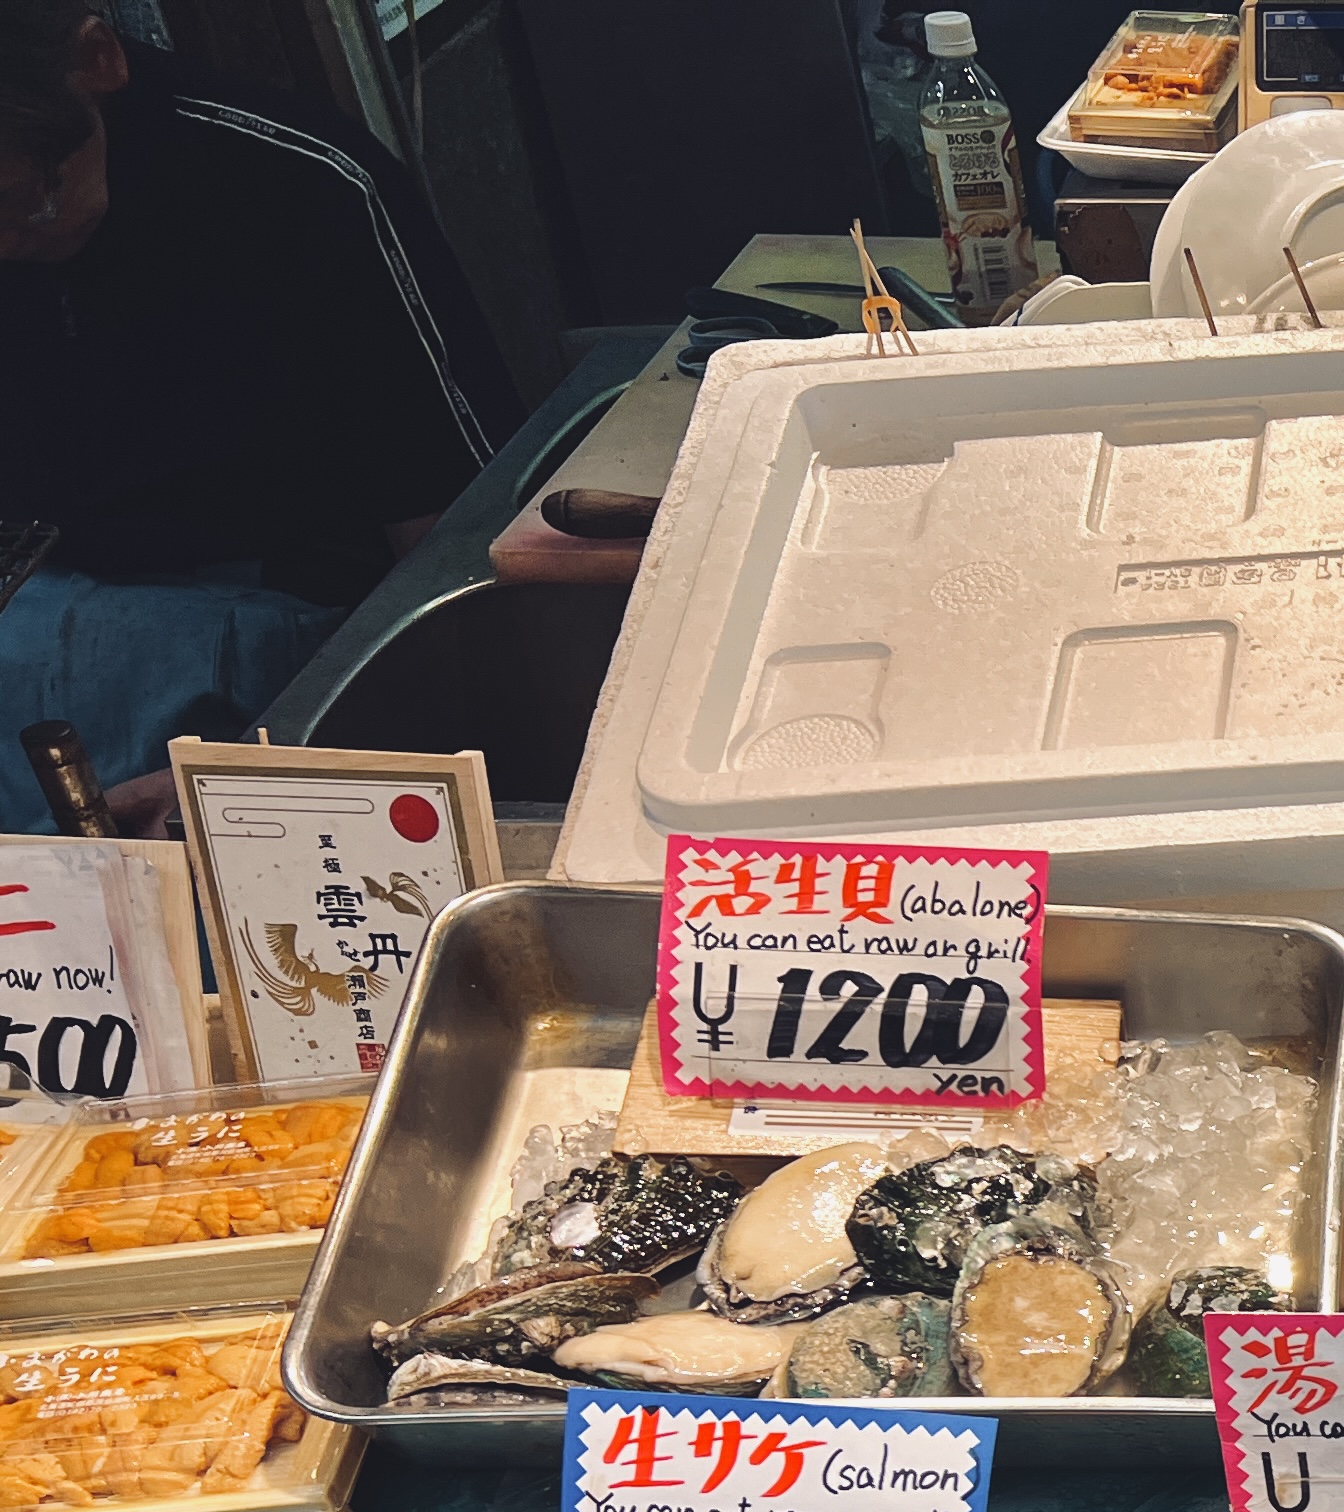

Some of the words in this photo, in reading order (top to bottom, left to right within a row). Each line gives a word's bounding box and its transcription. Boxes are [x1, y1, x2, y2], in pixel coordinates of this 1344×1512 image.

[946, 132, 981, 146] BOSS
[952, 169, 1001, 183] カフェオレ
[685, 854, 896, 925] 活生貝
[899, 881, 1042, 925] (abalone)
[315, 884, 413, 975] 雲丹
[685, 920, 739, 952] You
[746, 932, 799, 952] can
[806, 923, 856, 955] eat
[863, 936, 918, 955] raw
[924, 939, 958, 959] or
[0, 967, 43, 992] aw
[53, 945, 115, 994] now!
[346, 974, 376, 1041] 瀬戸商店
[932, 1073, 1006, 1097] yen
[150, 1125, 244, 1147] 生うに
[12, 1365, 120, 1392] 生うに
[1249, 1410, 1312, 1445] You
[602, 1405, 829, 1499] 生サケ
[821, 1442, 982, 1502] (salmon)
